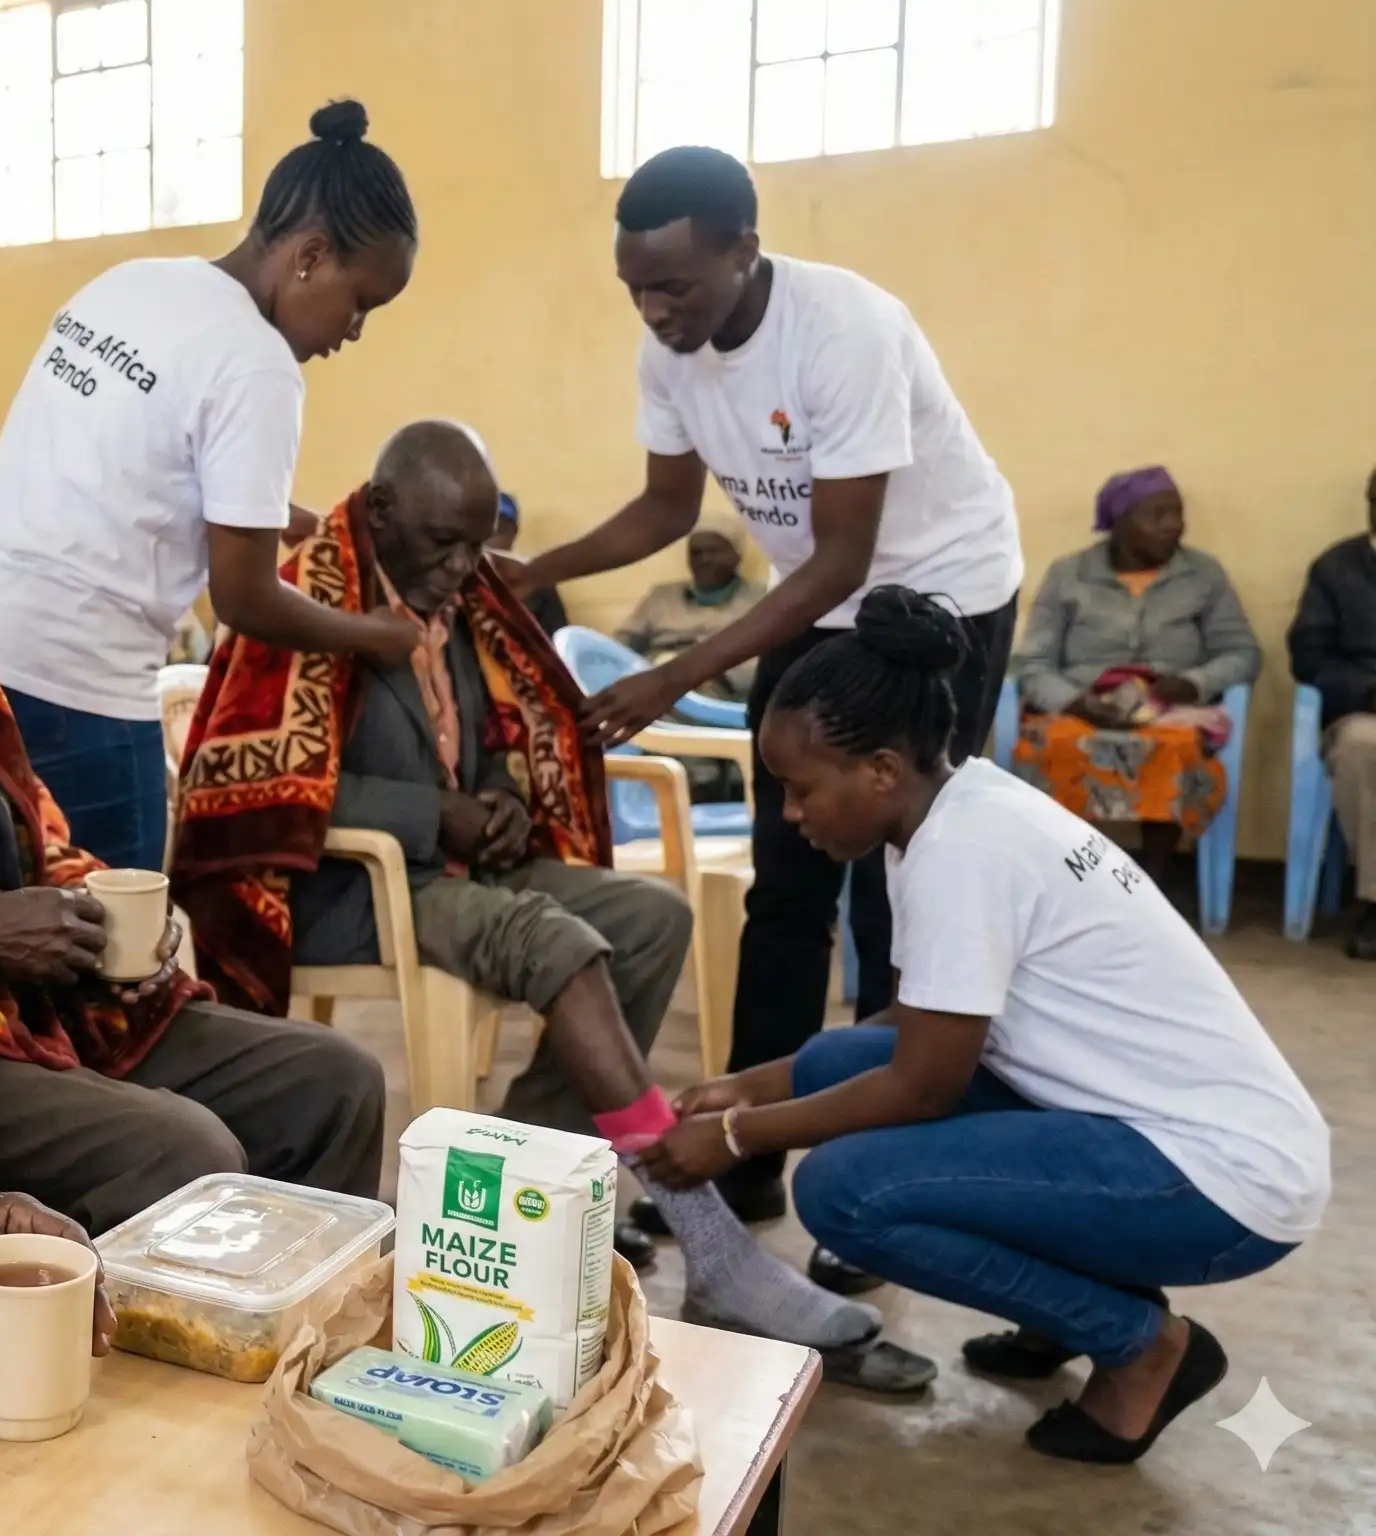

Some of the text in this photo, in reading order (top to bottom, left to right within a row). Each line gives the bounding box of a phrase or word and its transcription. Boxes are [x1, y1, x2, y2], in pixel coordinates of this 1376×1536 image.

[43, 346, 97, 397] Pendo
[90, 335, 157, 395] Africa
[721, 476, 811, 501] ma Afric
[422, 1223, 517, 1267] MAIZE
[425, 1250, 509, 1289] FLOUR
